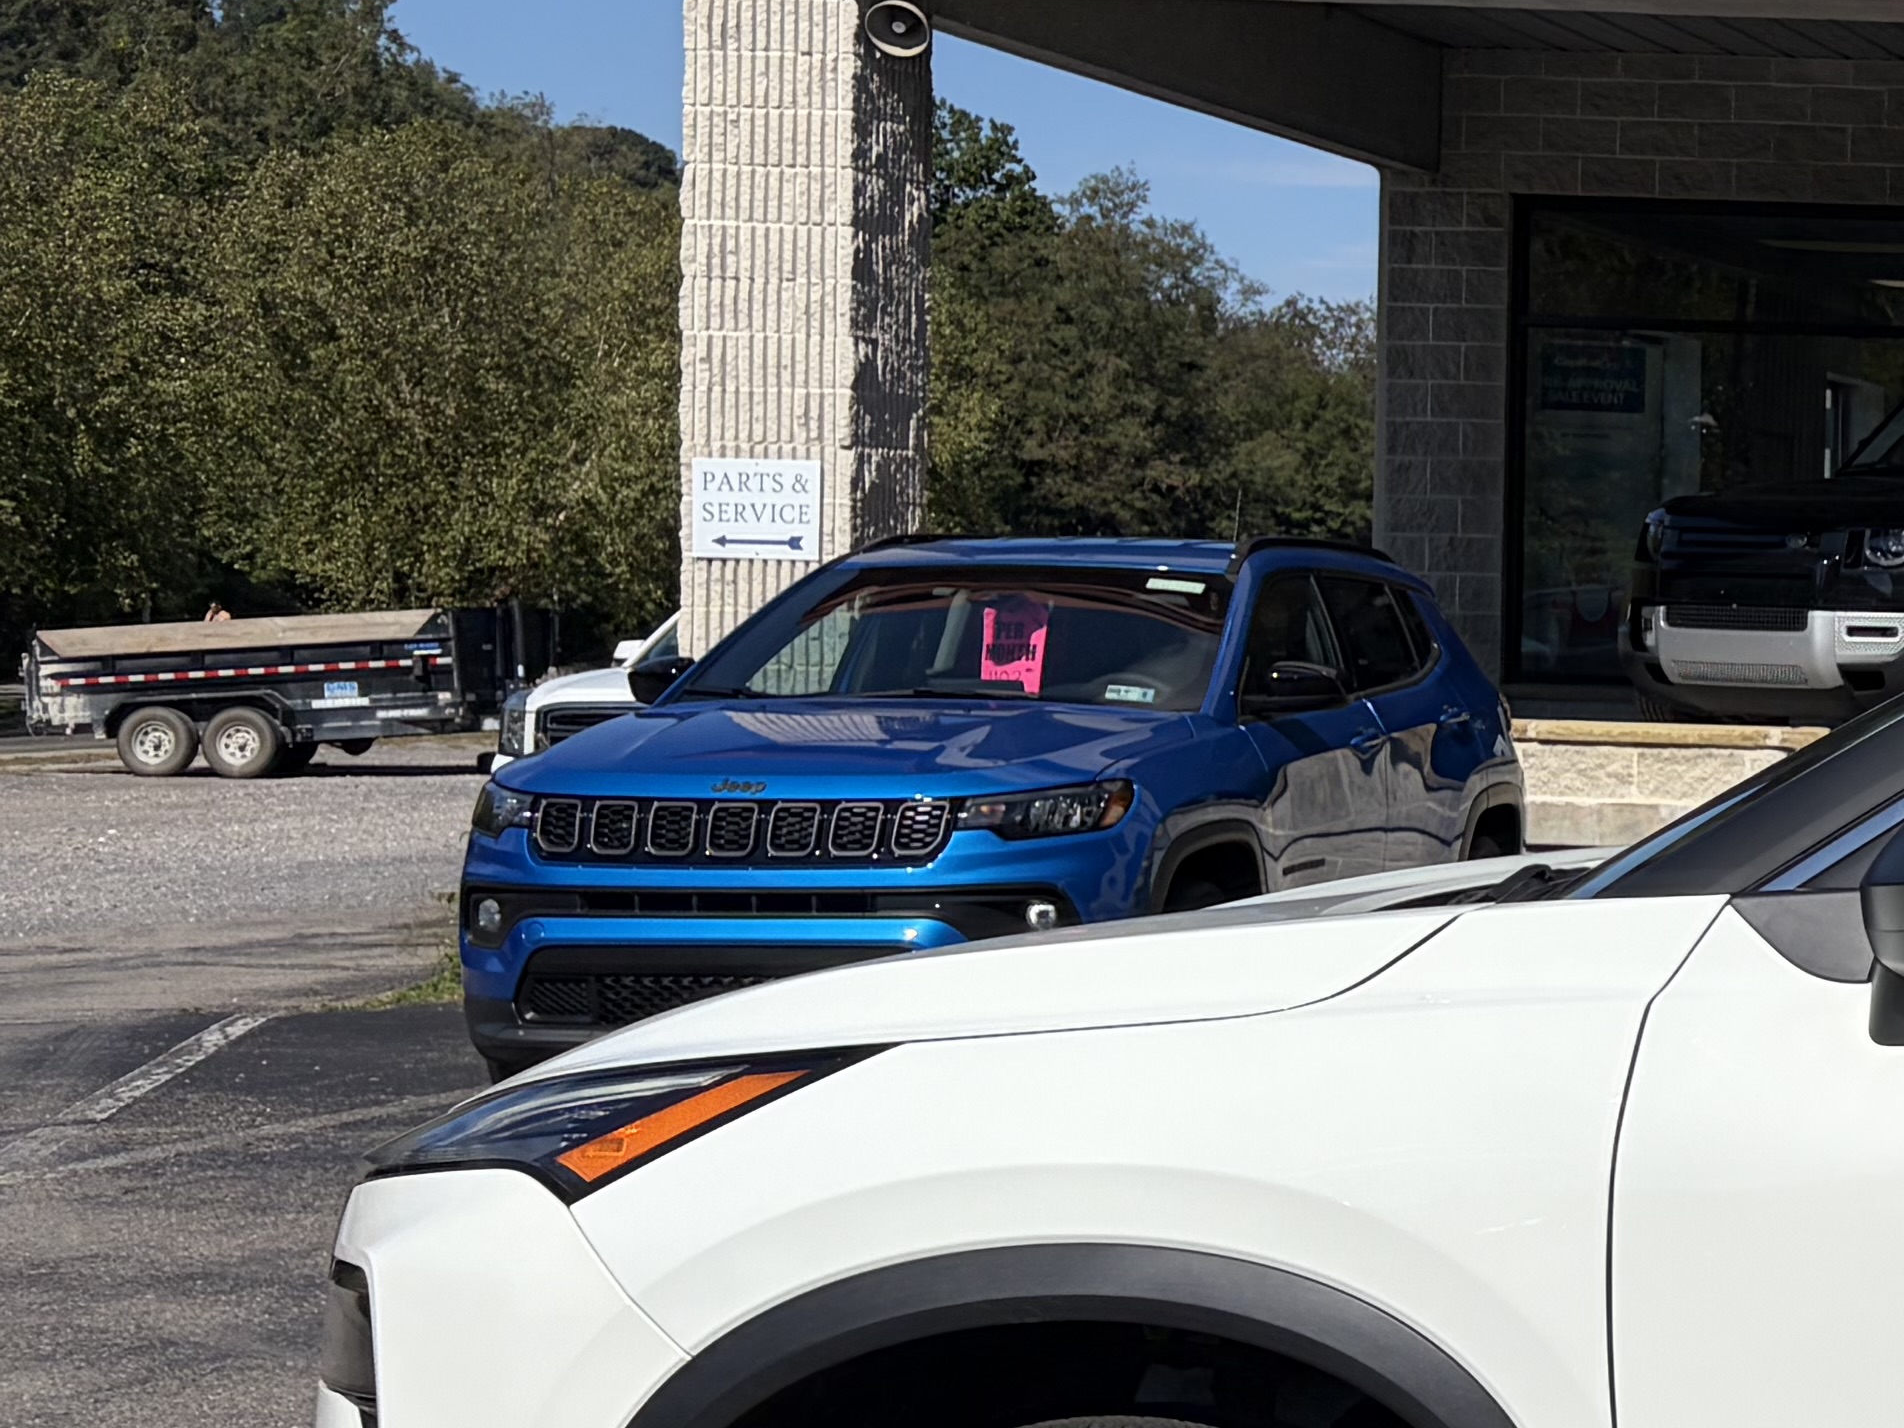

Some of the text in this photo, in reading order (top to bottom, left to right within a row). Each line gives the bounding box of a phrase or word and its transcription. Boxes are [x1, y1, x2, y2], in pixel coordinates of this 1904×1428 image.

[702, 470, 809, 495] PARTS &
[702, 502, 811, 525] SERVICE
[985, 644, 1037, 661] MONTH
[711, 778, 768, 795] Jeep
